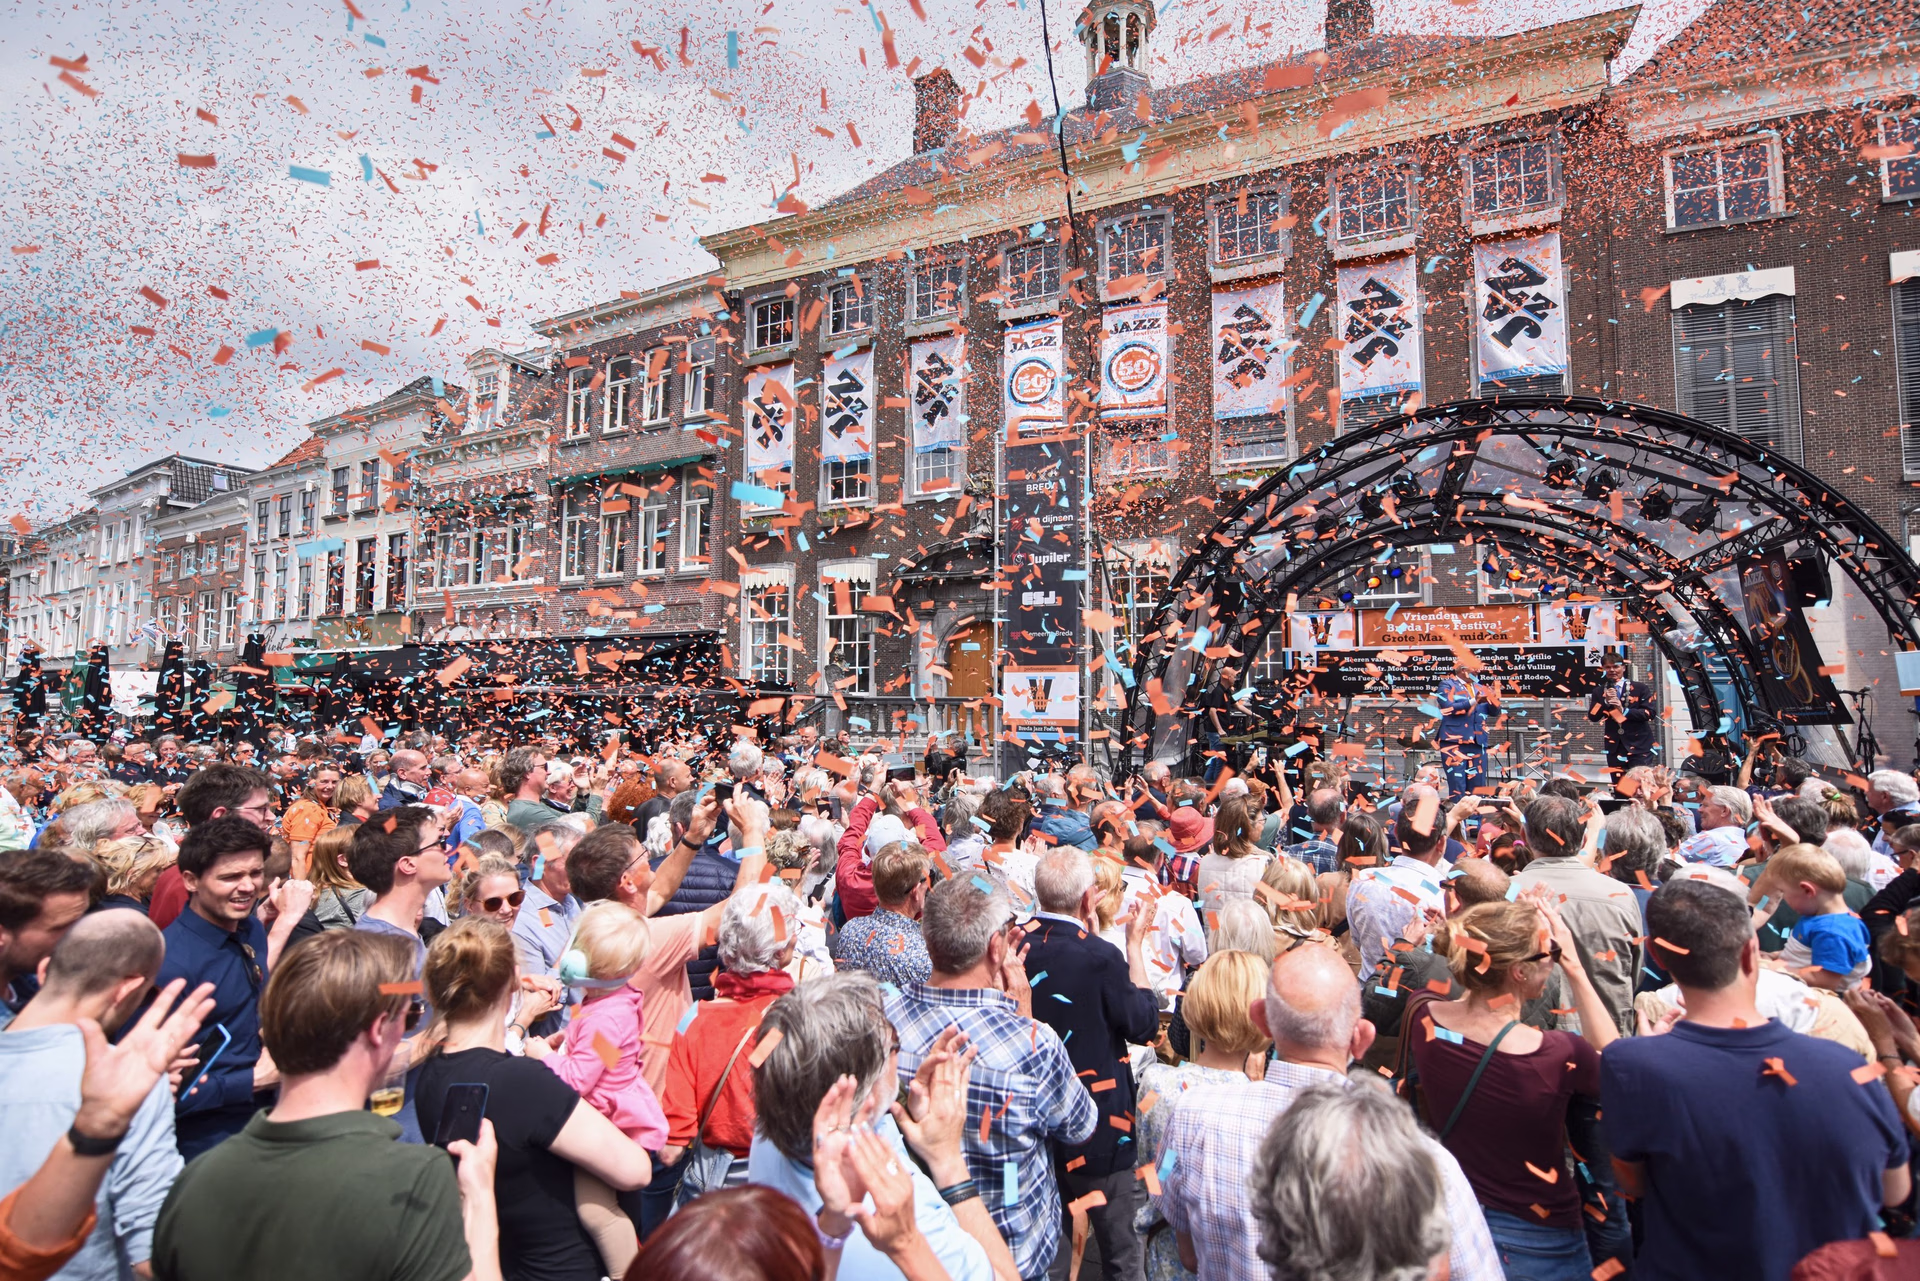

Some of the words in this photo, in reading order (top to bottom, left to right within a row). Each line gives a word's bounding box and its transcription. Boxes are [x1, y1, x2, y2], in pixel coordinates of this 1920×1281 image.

[1110, 317, 1161, 335] JAZZ
[1010, 335, 1057, 353] JAZZ
[1118, 359, 1151, 375] 50
[1025, 516, 1040, 524] vn
[1042, 514, 1074, 524] dijnsen
[1028, 552, 1071, 566] Jupiler
[1402, 611, 1459, 622] Vrienden
[1462, 611, 1485, 620] van
[1381, 634, 1418, 643] Grote
[1459, 631, 1508, 641] midden
